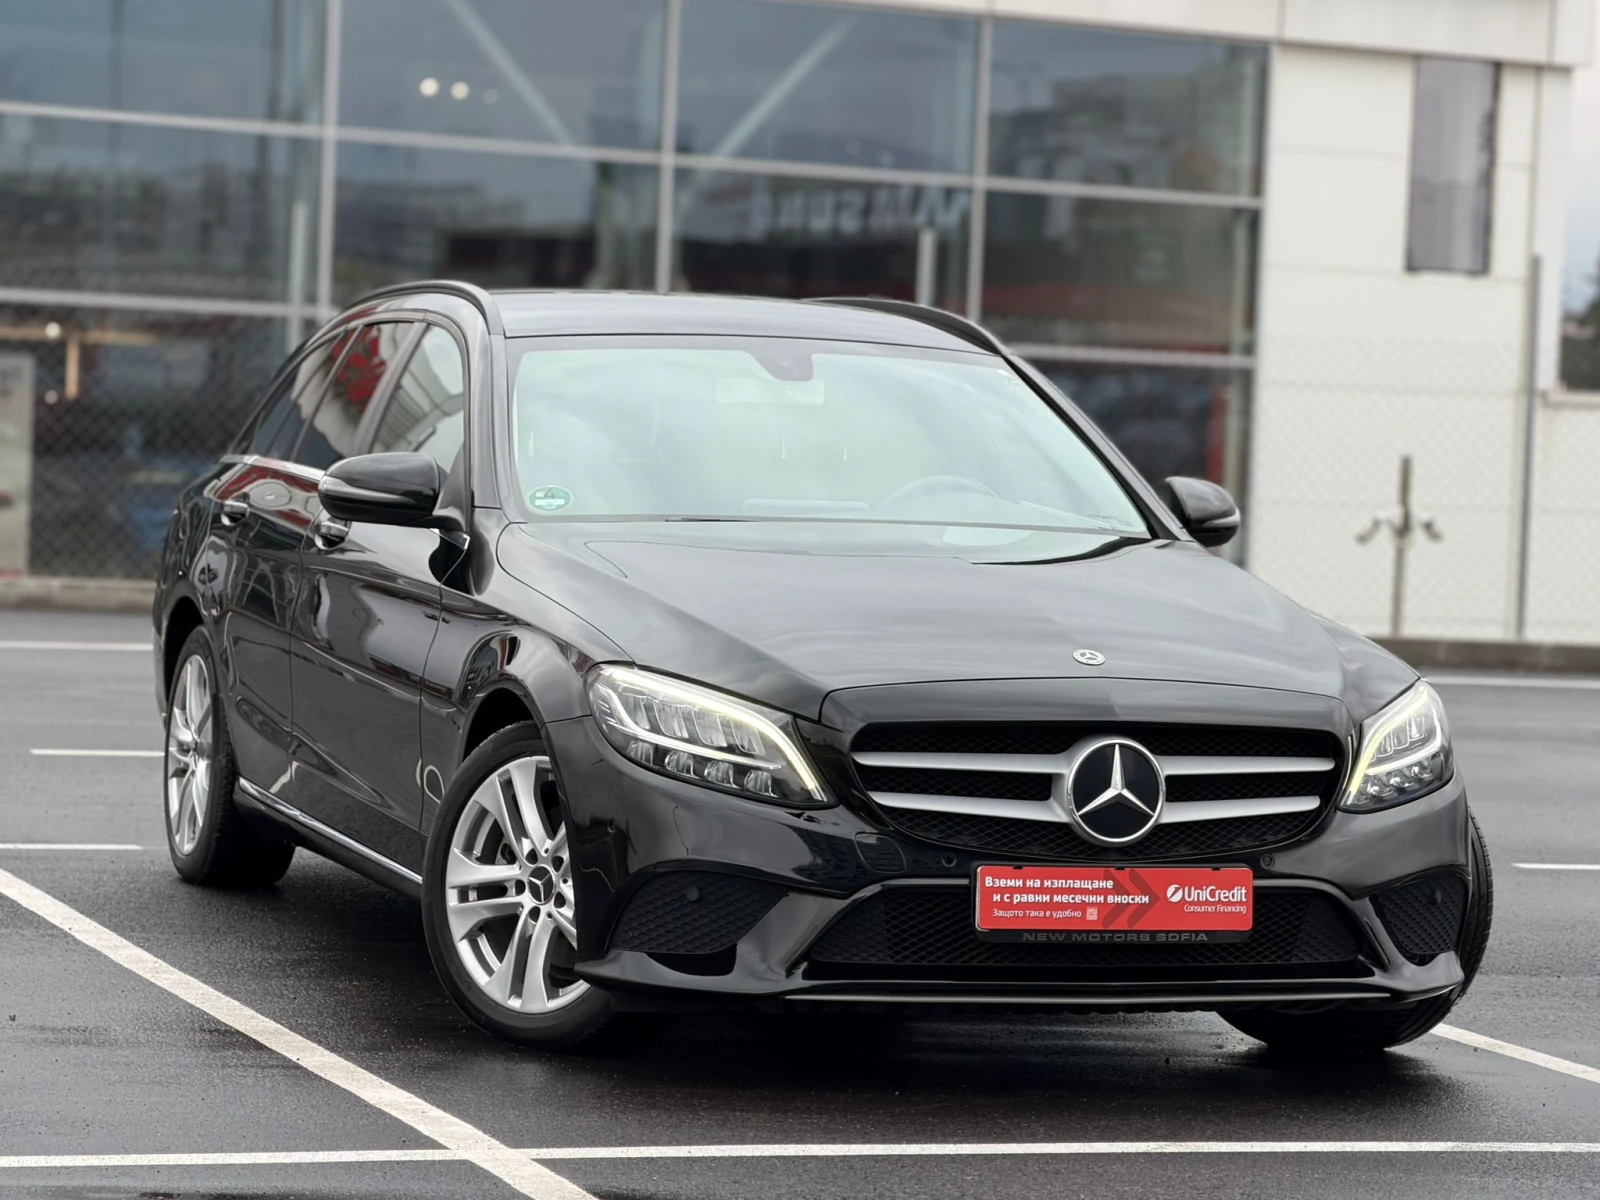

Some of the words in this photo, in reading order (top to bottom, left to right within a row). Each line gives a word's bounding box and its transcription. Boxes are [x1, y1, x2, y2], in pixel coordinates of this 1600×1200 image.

[985, 876, 1023, 887] Вземи
[1026, 879, 1040, 888] на
[1044, 879, 1114, 890] изплащане
[993, 893, 1001, 902] и
[1003, 893, 1011, 902] с
[1013, 893, 1050, 905] равни
[1053, 894, 1104, 903] месечни
[1107, 894, 1149, 904] вноски
[1184, 885, 1247, 902] UniCredit
[992, 908, 1024, 918] Защото
[1052, 909, 1082, 918] удобно
[1184, 904, 1216, 913] Consumer
[1217, 904, 1247, 914] Financing
[1022, 932, 1065, 942] NEW
[1072, 932, 1150, 942] MOTORS
[1155, 932, 1208, 942] SOFIA
